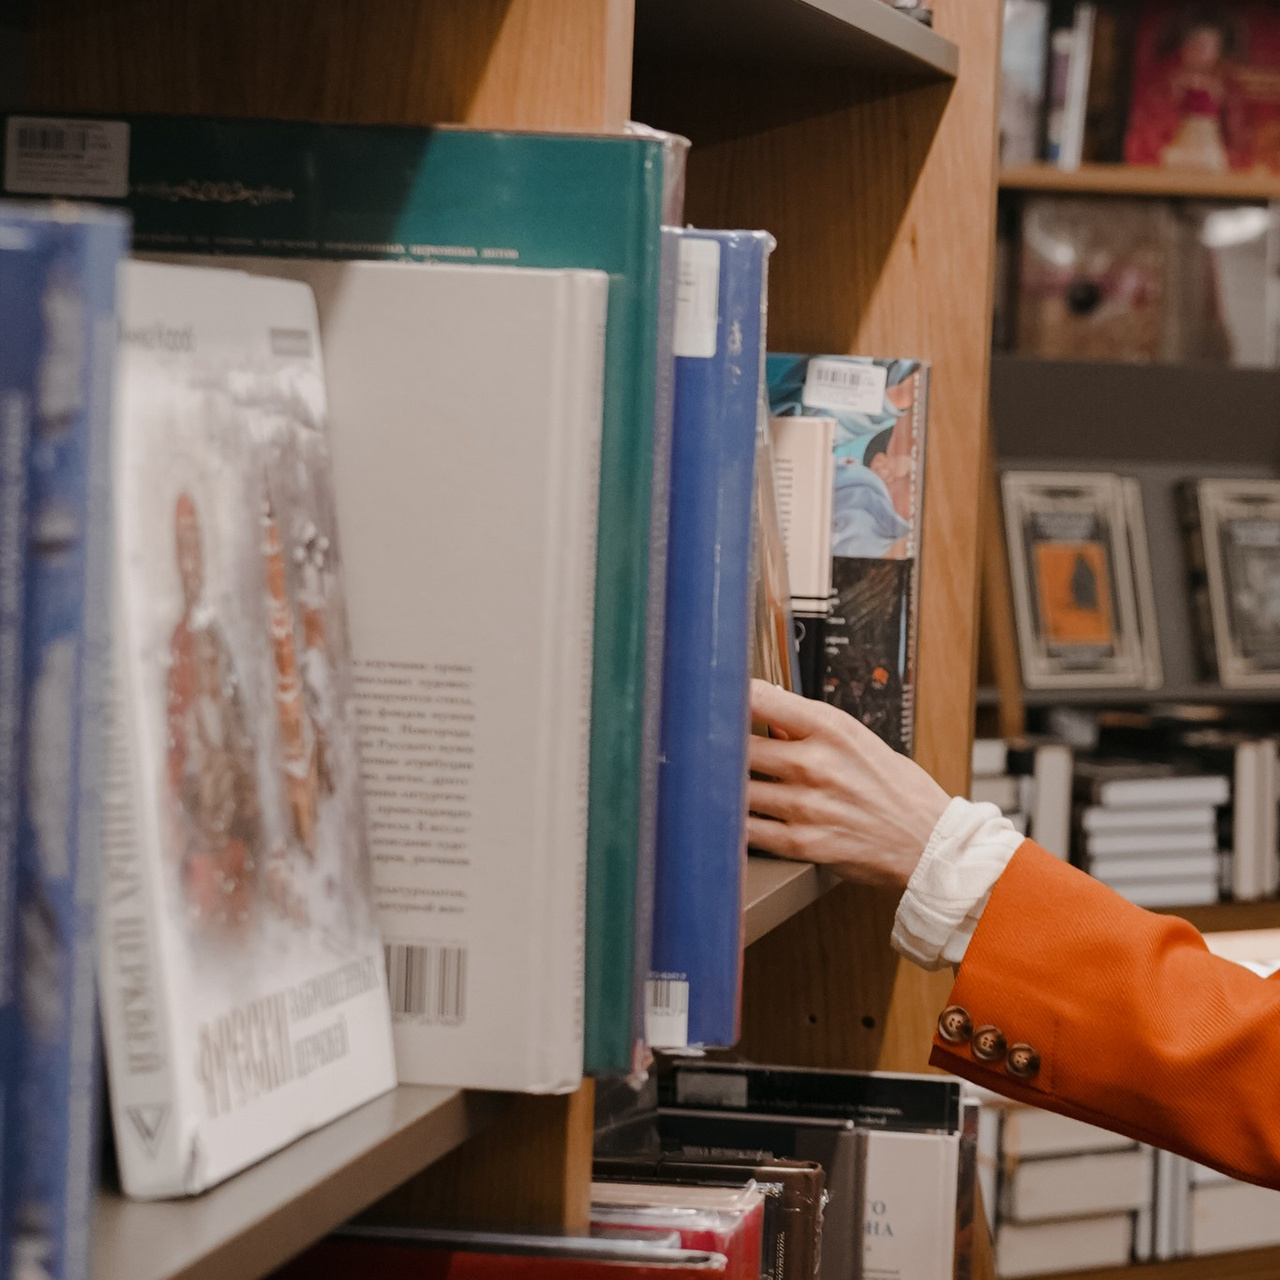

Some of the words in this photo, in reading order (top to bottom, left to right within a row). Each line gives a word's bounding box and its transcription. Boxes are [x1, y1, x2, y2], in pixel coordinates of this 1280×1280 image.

[196, 990, 294, 1120] ФРЕСКИ
[288, 954, 381, 1019] ЗАБРОШЕННЫХ
[294, 1011, 351, 1080] ЦЕРКВЕЙ
